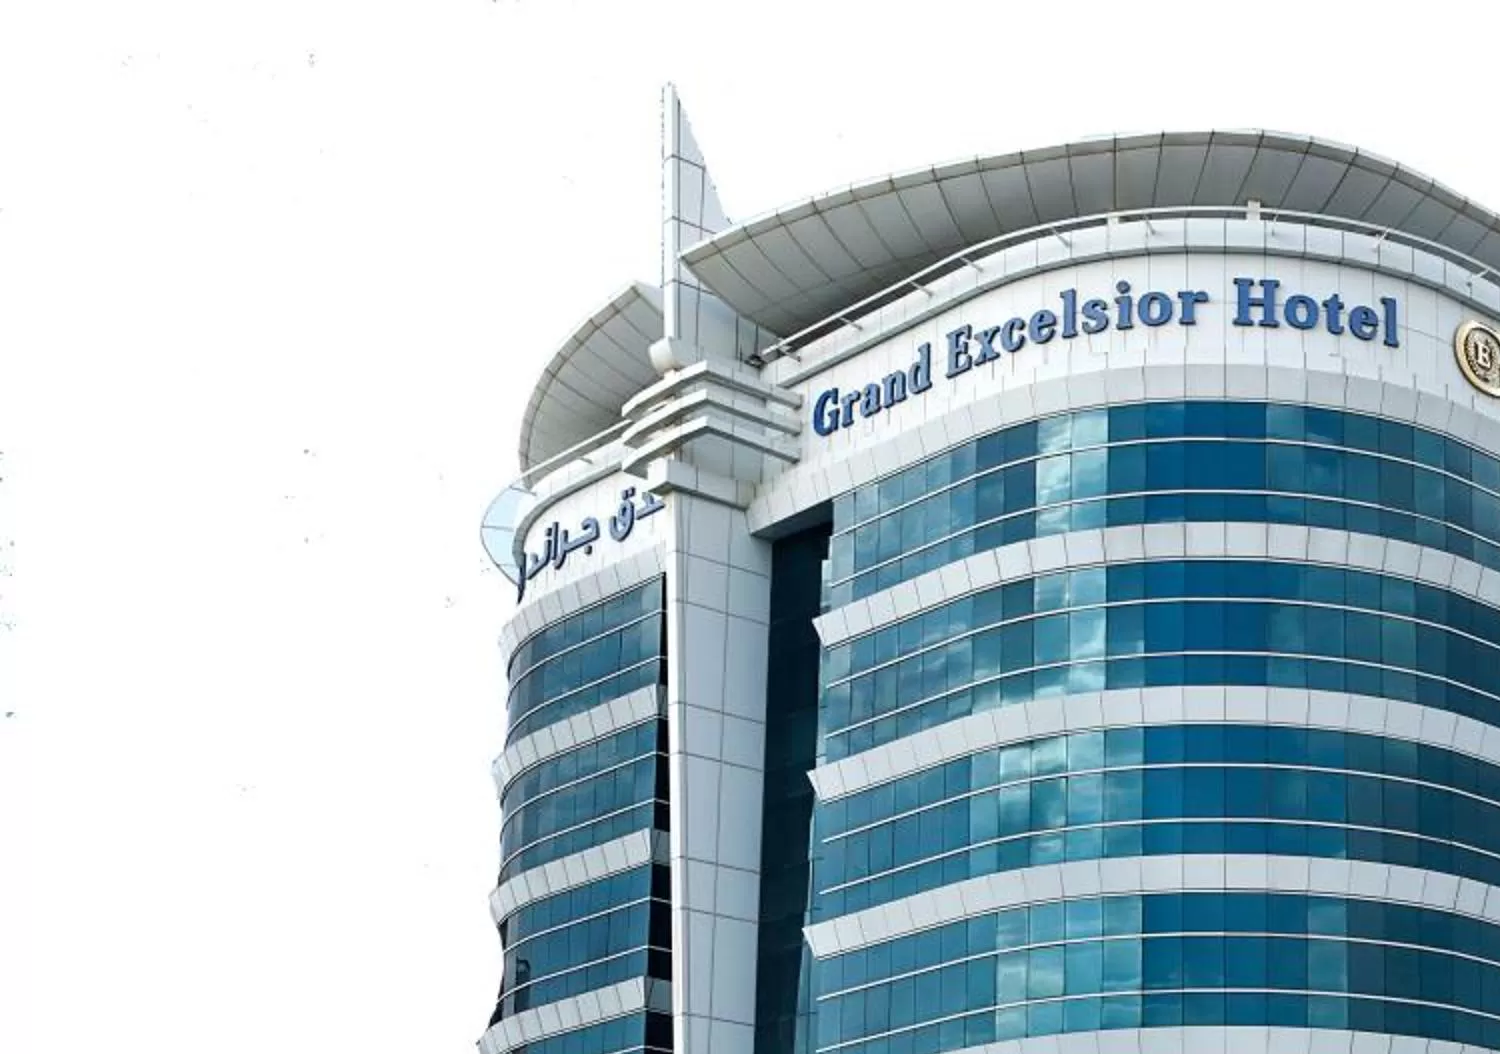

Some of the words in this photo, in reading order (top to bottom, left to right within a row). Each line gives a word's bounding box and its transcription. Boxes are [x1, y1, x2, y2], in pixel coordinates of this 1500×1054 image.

[812, 343, 932, 437] Grand
[945, 281, 1208, 379] Excelsior
[1232, 277, 1400, 347] Hotel
